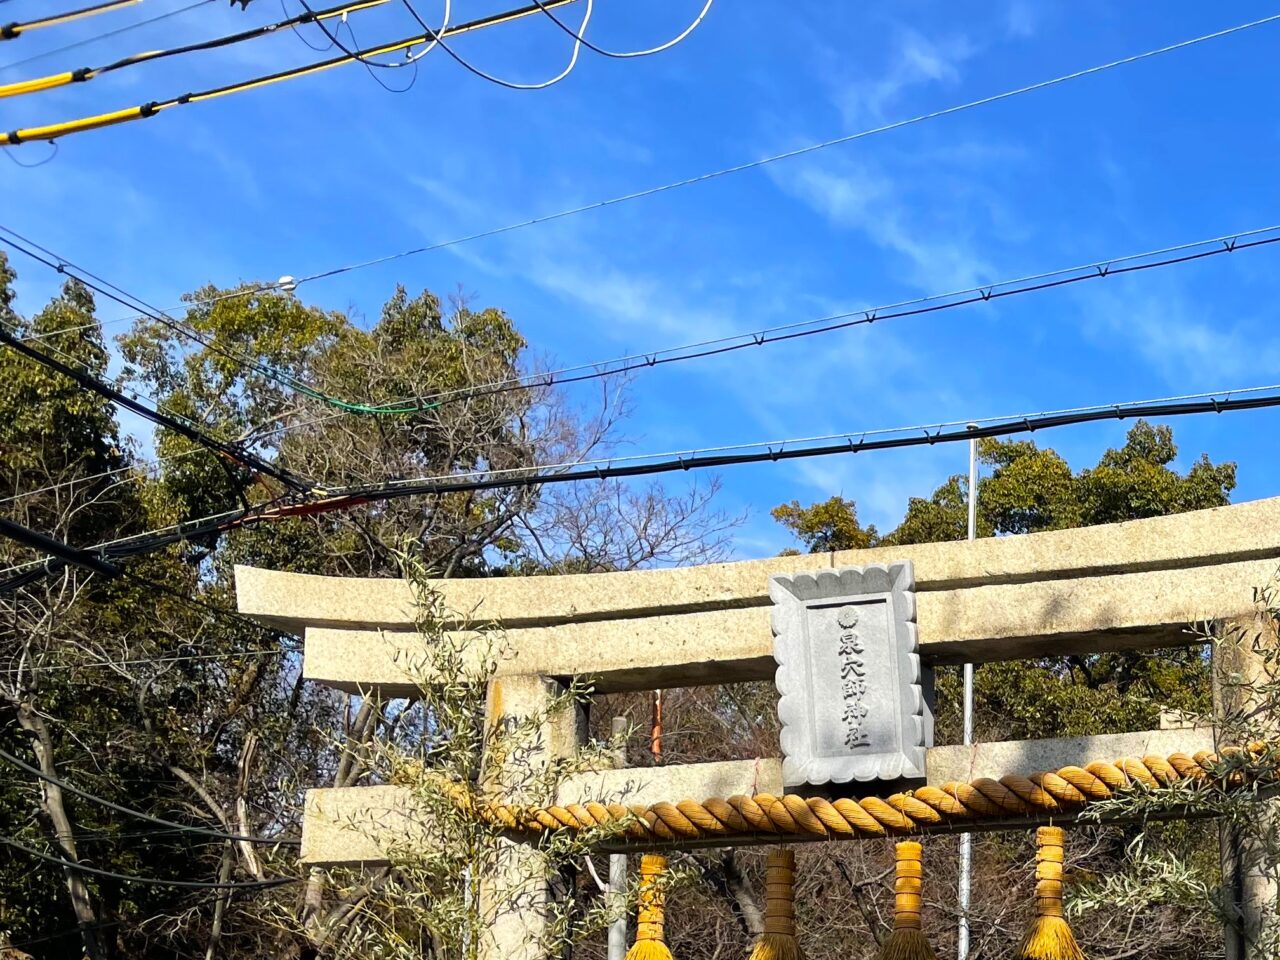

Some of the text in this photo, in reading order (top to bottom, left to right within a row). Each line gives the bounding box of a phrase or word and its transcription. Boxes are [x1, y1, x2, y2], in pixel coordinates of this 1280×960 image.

[838, 632, 870, 750] 泉穴師神社
